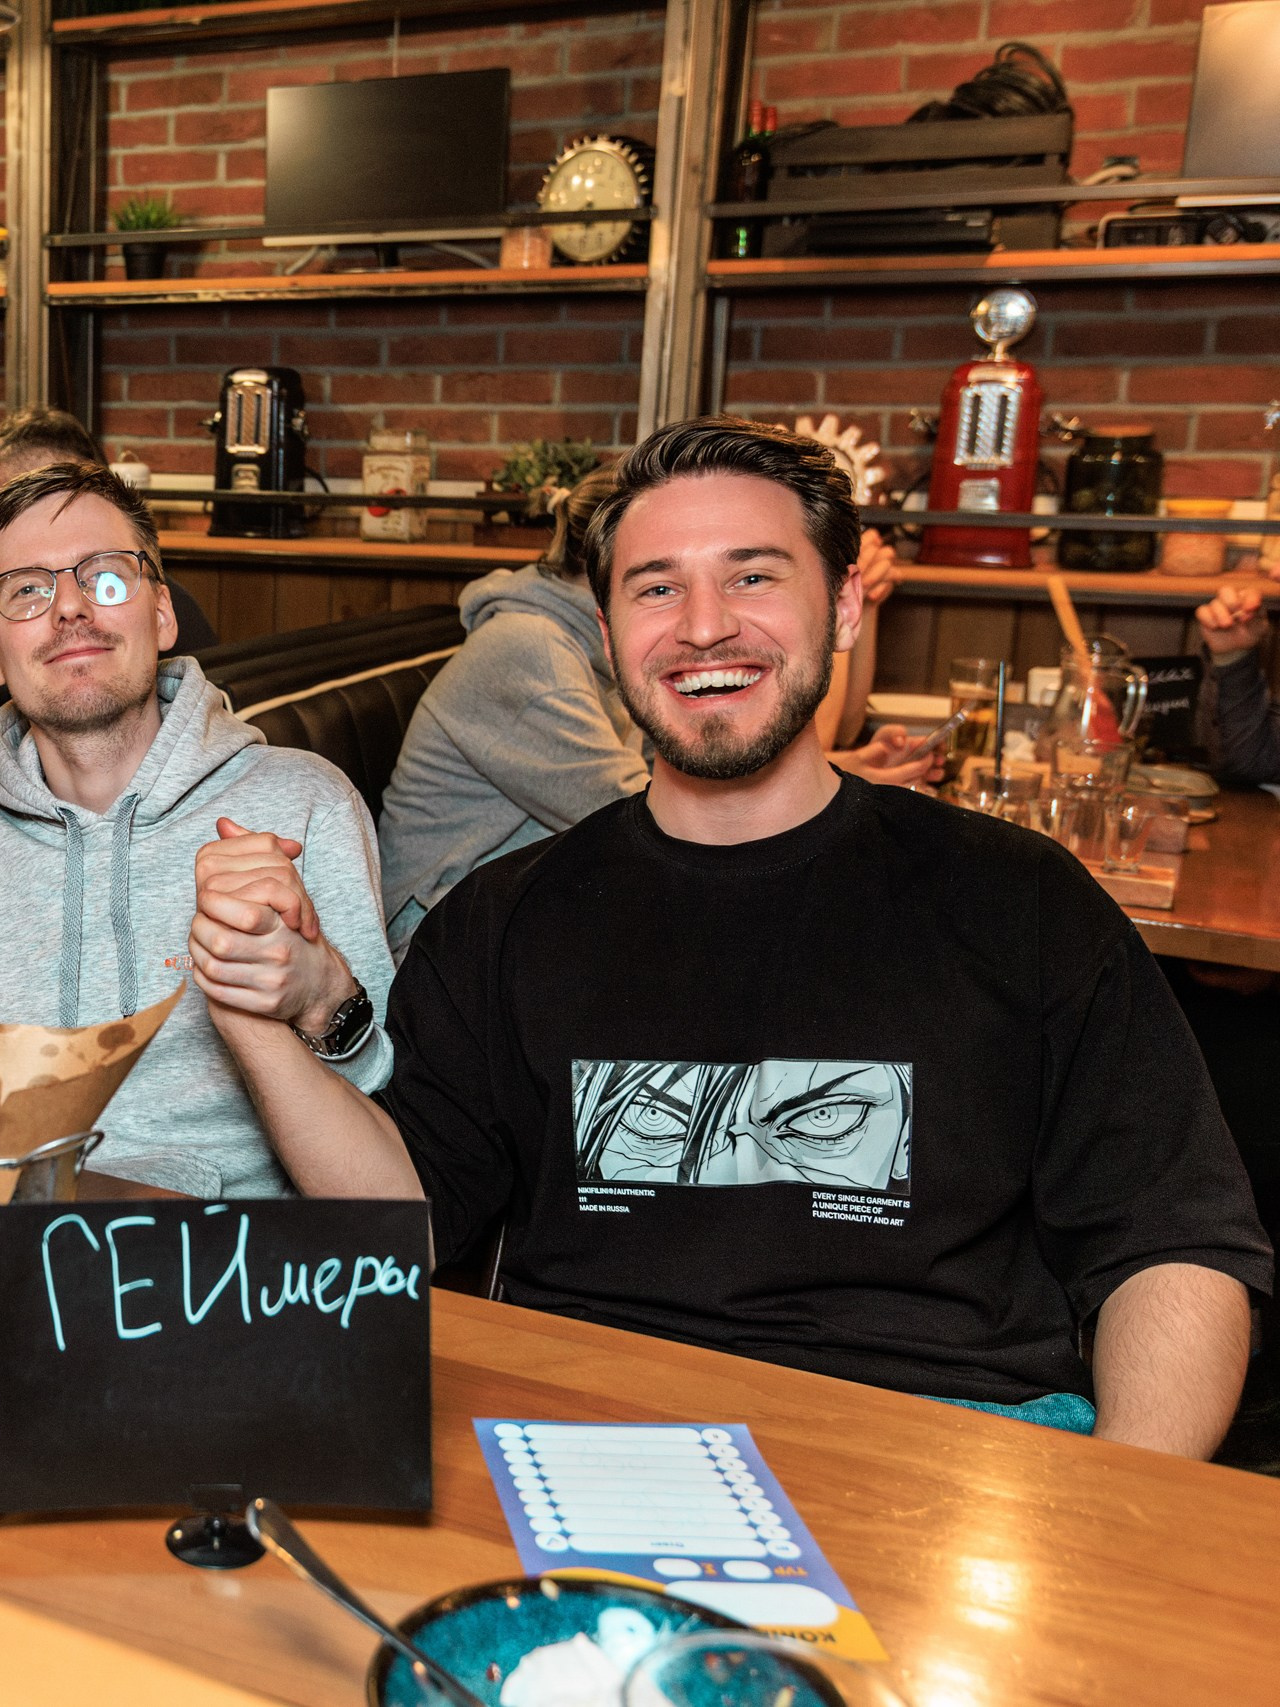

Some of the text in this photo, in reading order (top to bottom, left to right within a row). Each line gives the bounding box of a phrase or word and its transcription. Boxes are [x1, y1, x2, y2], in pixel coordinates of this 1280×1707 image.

[812, 1191, 836, 1200] EVERY
[837, 1194, 865, 1203] SINGLE
[866, 1196, 902, 1207] GARMENT
[819, 1201, 849, 1211] UNIQUE
[849, 1205, 872, 1213] PIECE
[607, 1205, 630, 1213] RUSSIA
[812, 1209, 905, 1227] FUNCTIONALITY AND ART
[41, 1203, 420, 1352] ГЕЙмеры
